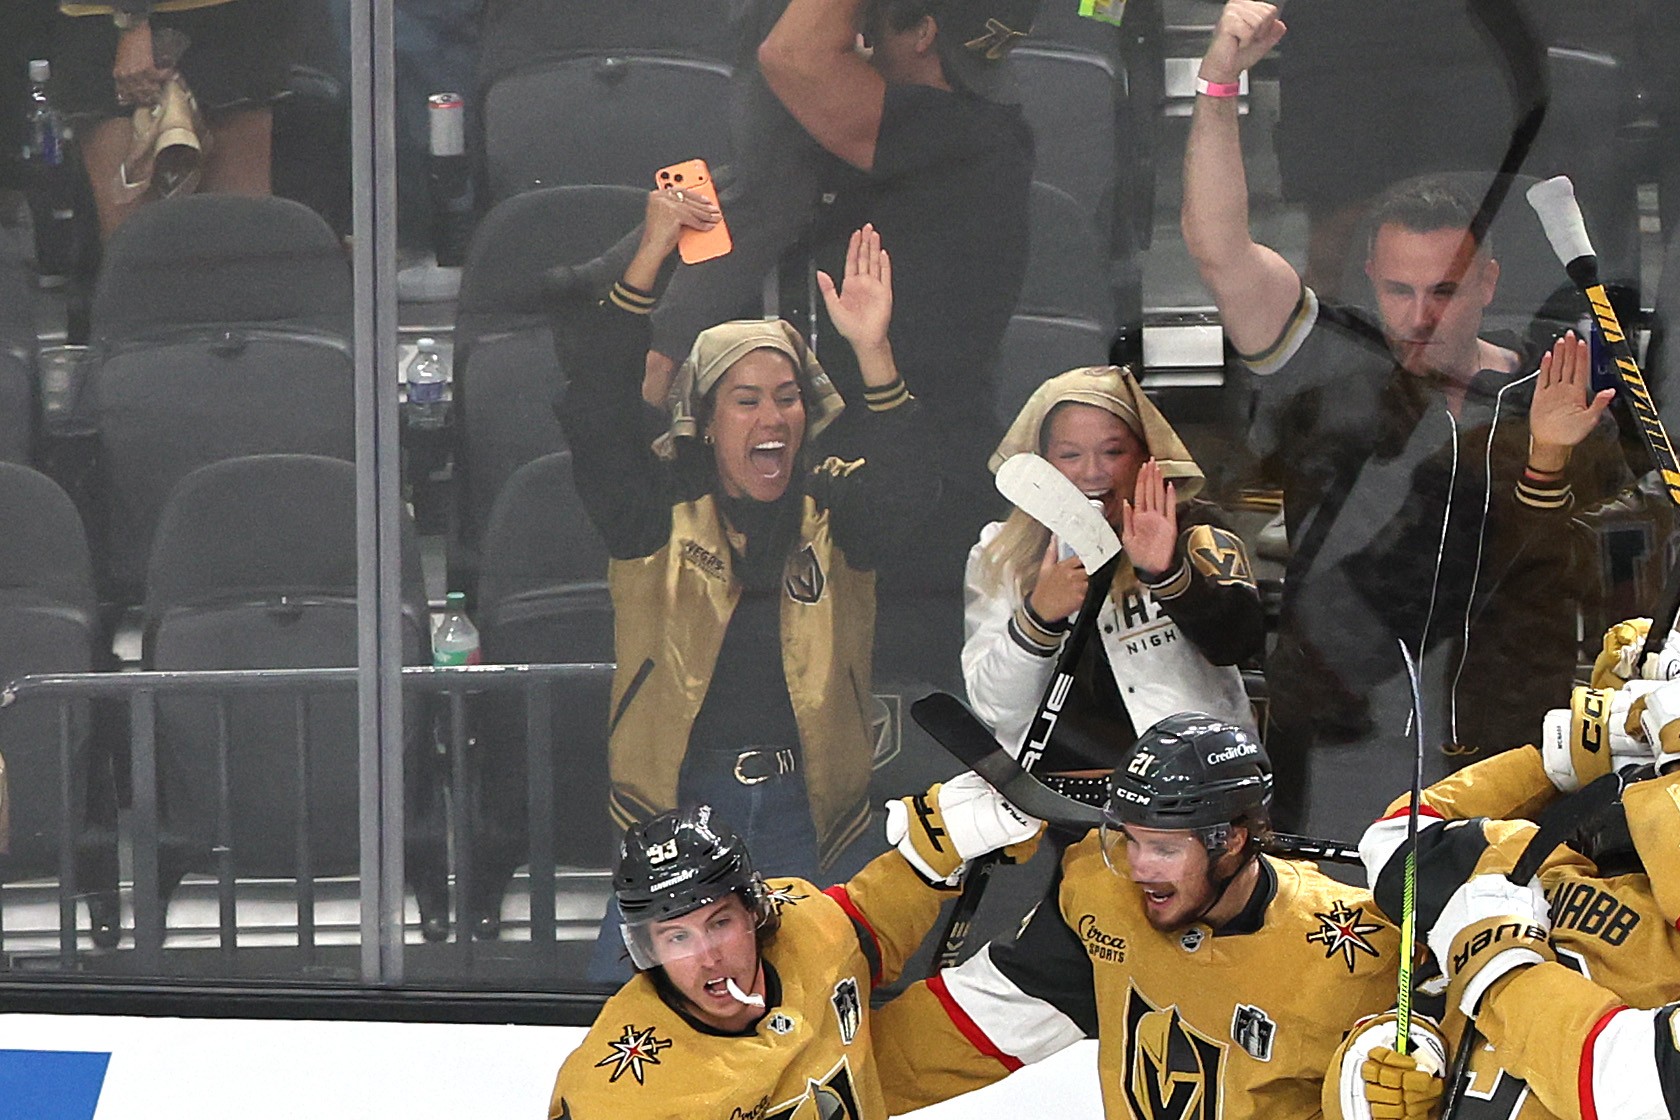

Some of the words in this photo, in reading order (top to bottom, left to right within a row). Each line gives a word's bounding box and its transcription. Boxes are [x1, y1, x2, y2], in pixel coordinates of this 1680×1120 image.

[1127, 752, 1156, 777] 21
[1206, 742, 1259, 767] CreditOne
[1115, 786, 1152, 806] CCM
[647, 837, 678, 866] 93
[1078, 914, 1127, 950] Circa
[1089, 943, 1126, 964] SPORTS
